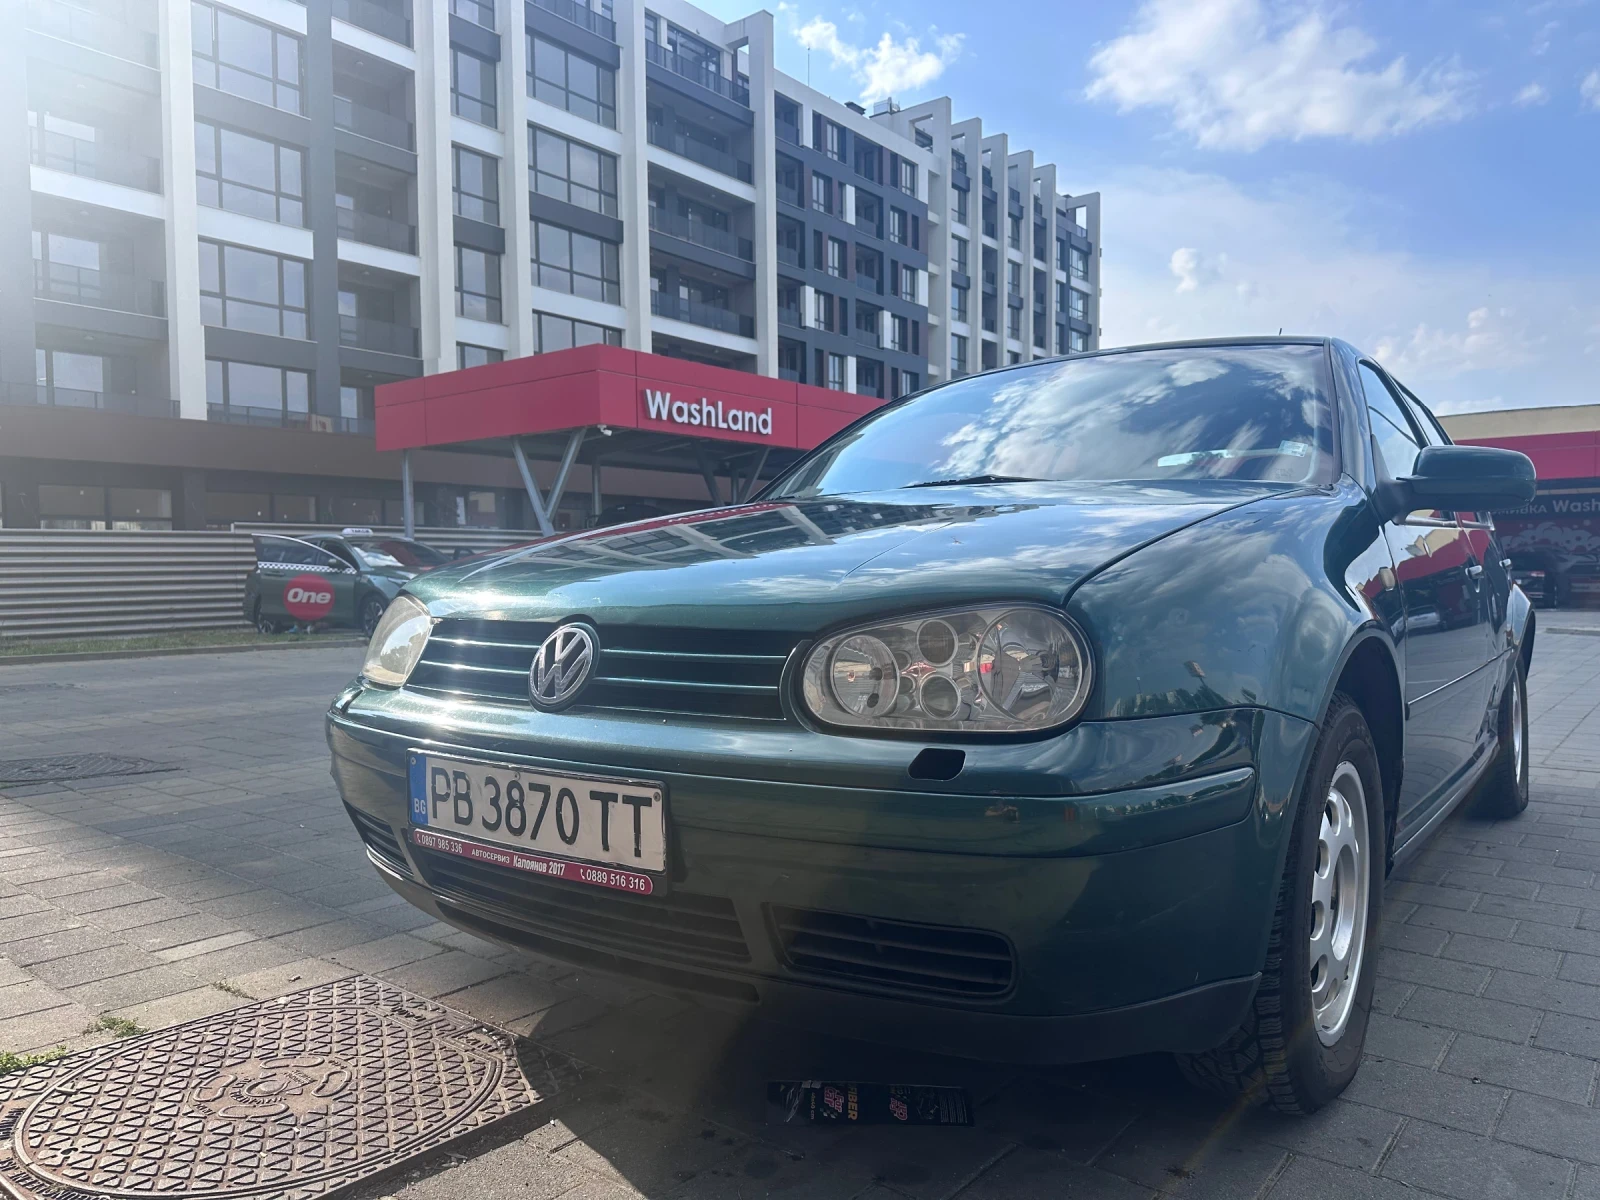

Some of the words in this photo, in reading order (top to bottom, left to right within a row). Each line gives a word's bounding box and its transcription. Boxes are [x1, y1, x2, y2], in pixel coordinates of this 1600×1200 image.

[645, 388, 772, 435] WashLand
[287, 587, 331, 604] One
[413, 797, 427, 815] BG
[481, 775, 580, 845] 3870
[589, 790, 653, 858] TT
[421, 834, 436, 847] 0897
[437, 838, 450, 850] 985
[450, 841, 463, 854] 336
[471, 848, 510, 864] АВТОСЕРВИЗ
[513, 855, 547, 873] Калоянов
[548, 861, 565, 876] 2017
[586, 869, 608, 883] 0889
[610, 874, 626, 888] 516
[628, 878, 645, 891] 316
